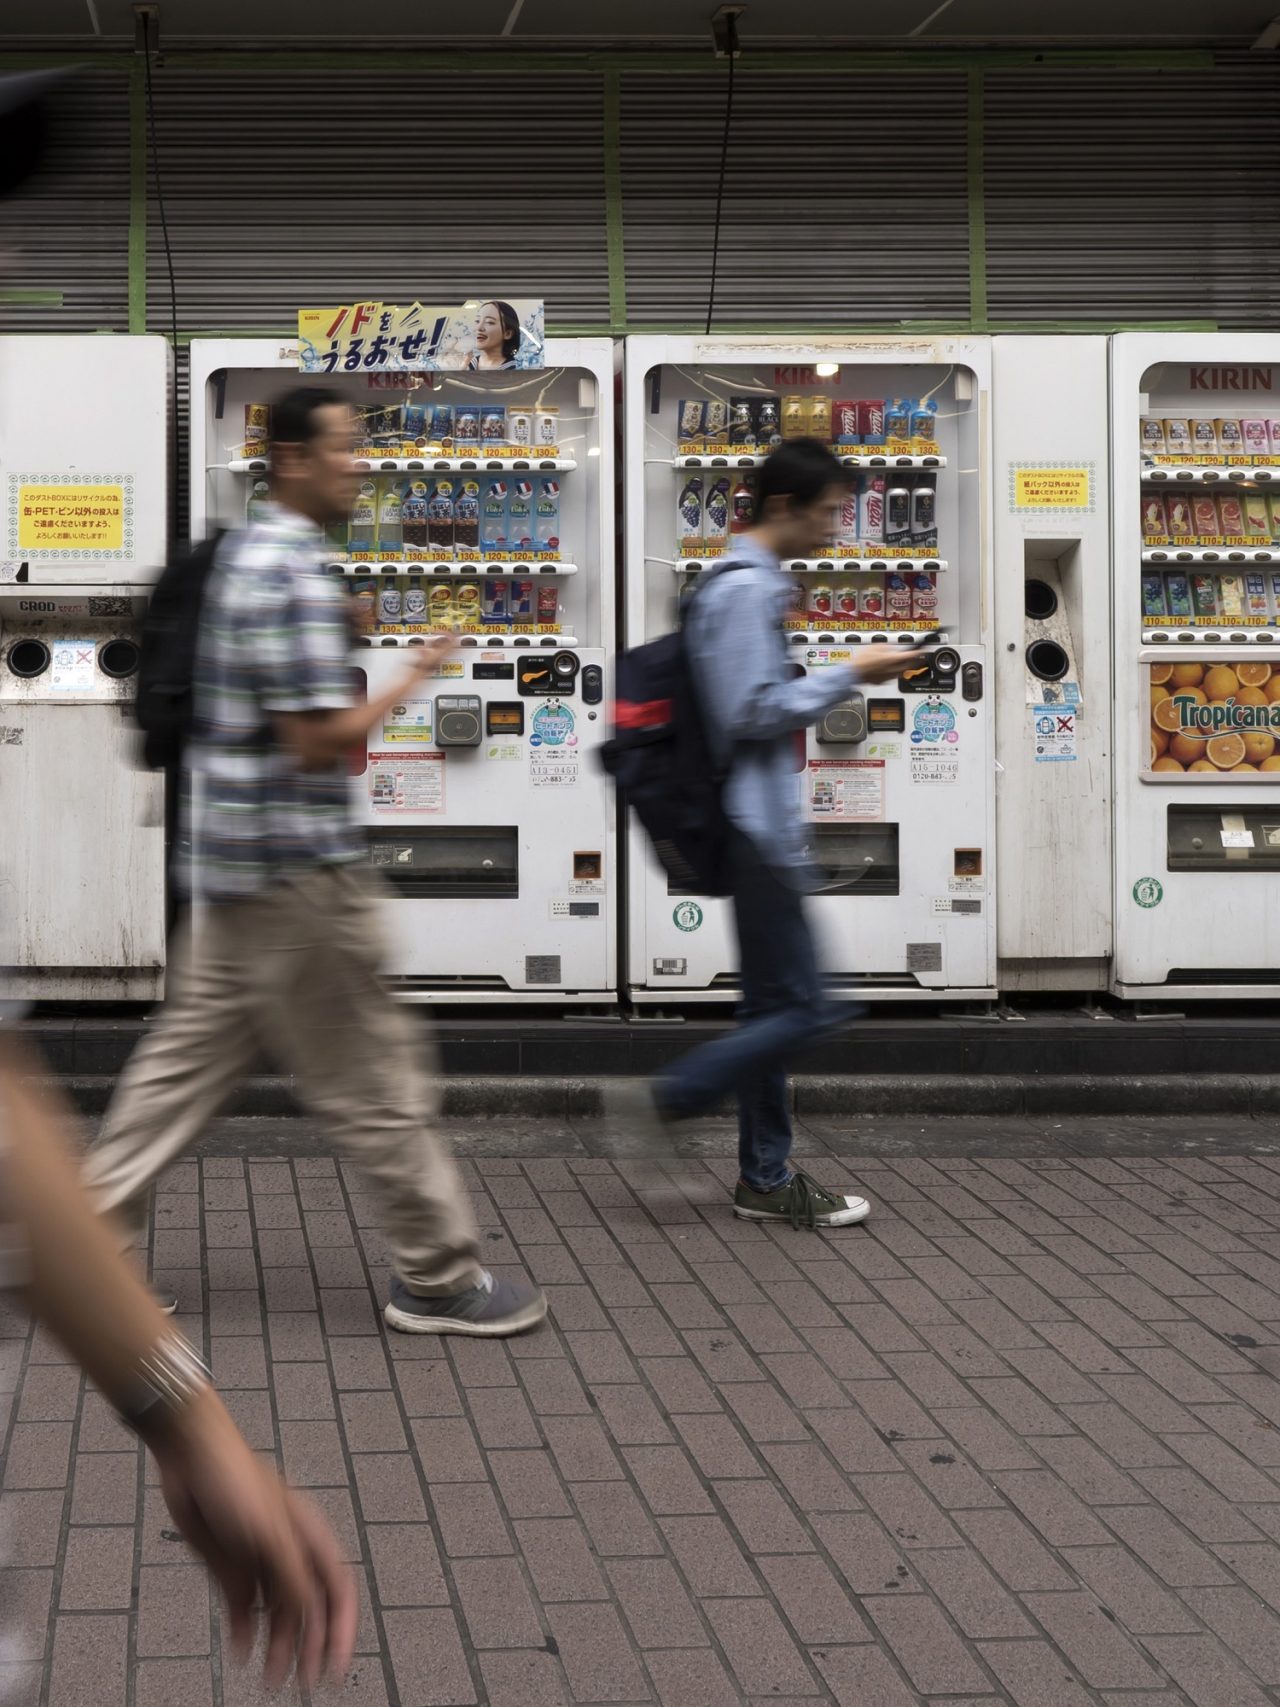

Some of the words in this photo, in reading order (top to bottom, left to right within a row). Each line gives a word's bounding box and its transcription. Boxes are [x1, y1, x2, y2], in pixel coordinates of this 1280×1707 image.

[326, 305, 392, 338] ノドを
[322, 316, 447, 373] うるおせ!
[774, 367, 841, 385] KIRN
[1189, 367, 1272, 390] KIRIN
[1173, 695, 1280, 731] Tropicana
